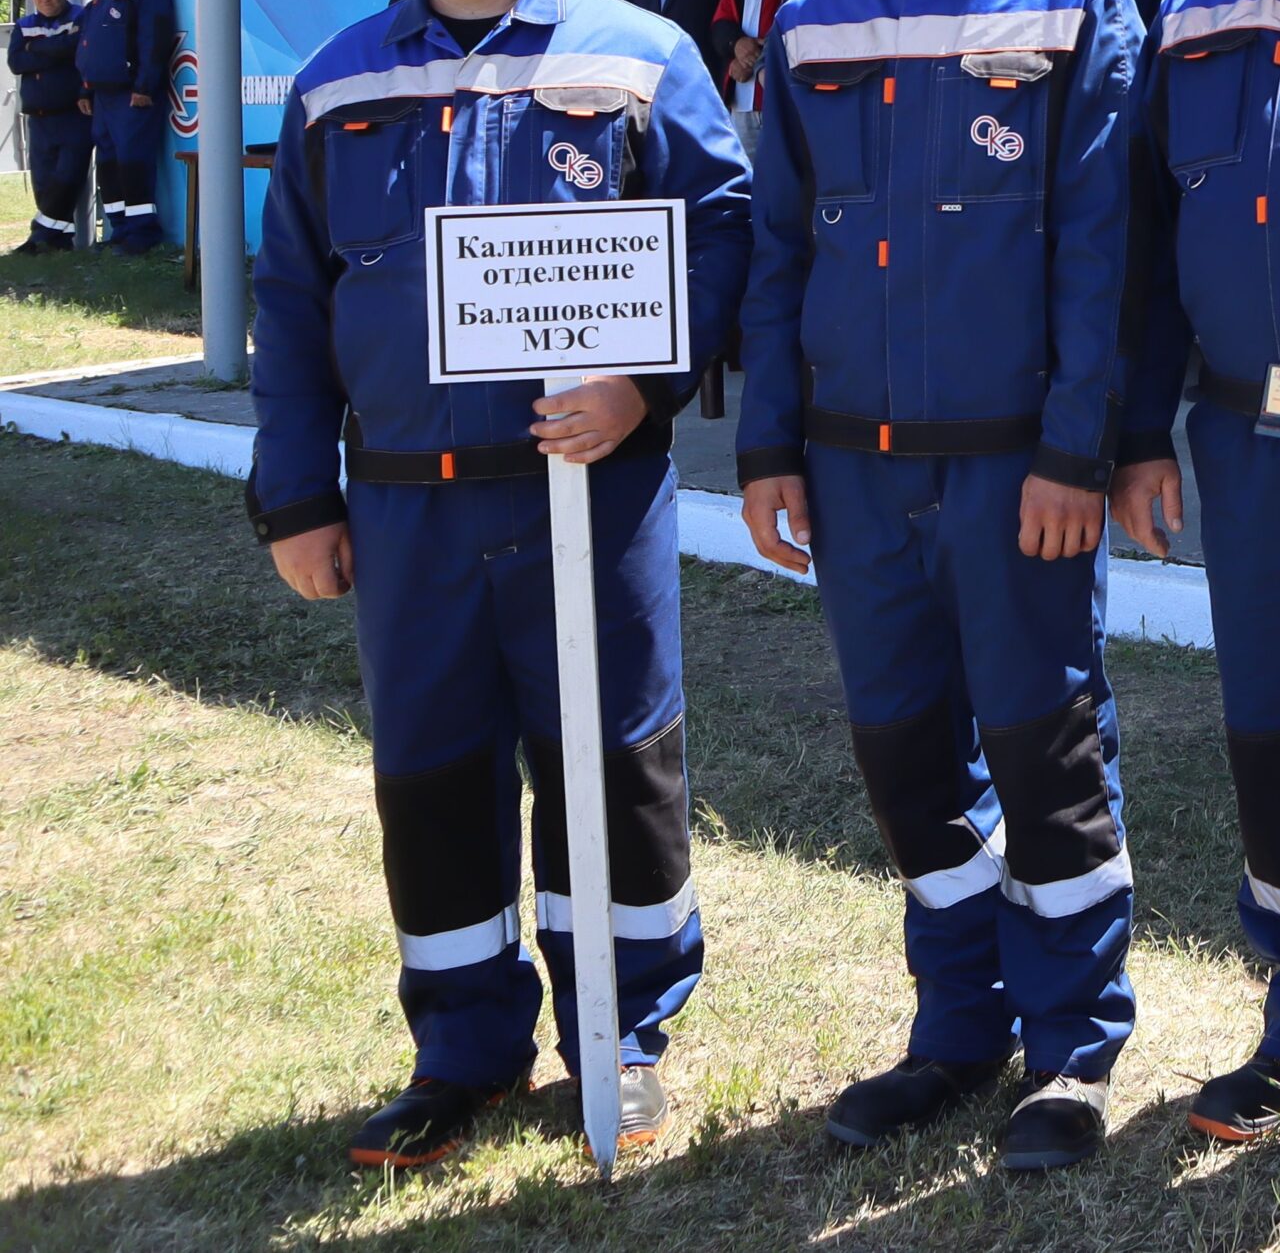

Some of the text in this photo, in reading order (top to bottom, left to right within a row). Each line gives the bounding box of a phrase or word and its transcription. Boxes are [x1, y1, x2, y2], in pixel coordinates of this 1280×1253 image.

[970, 115, 1024, 161] ОКЭ
[548, 142, 603, 189] ОКЭ
[457, 234, 659, 259] Калининское
[483, 262, 635, 286] отделение
[457, 300, 663, 326] Балашовские
[523, 326, 600, 352] МЭС
